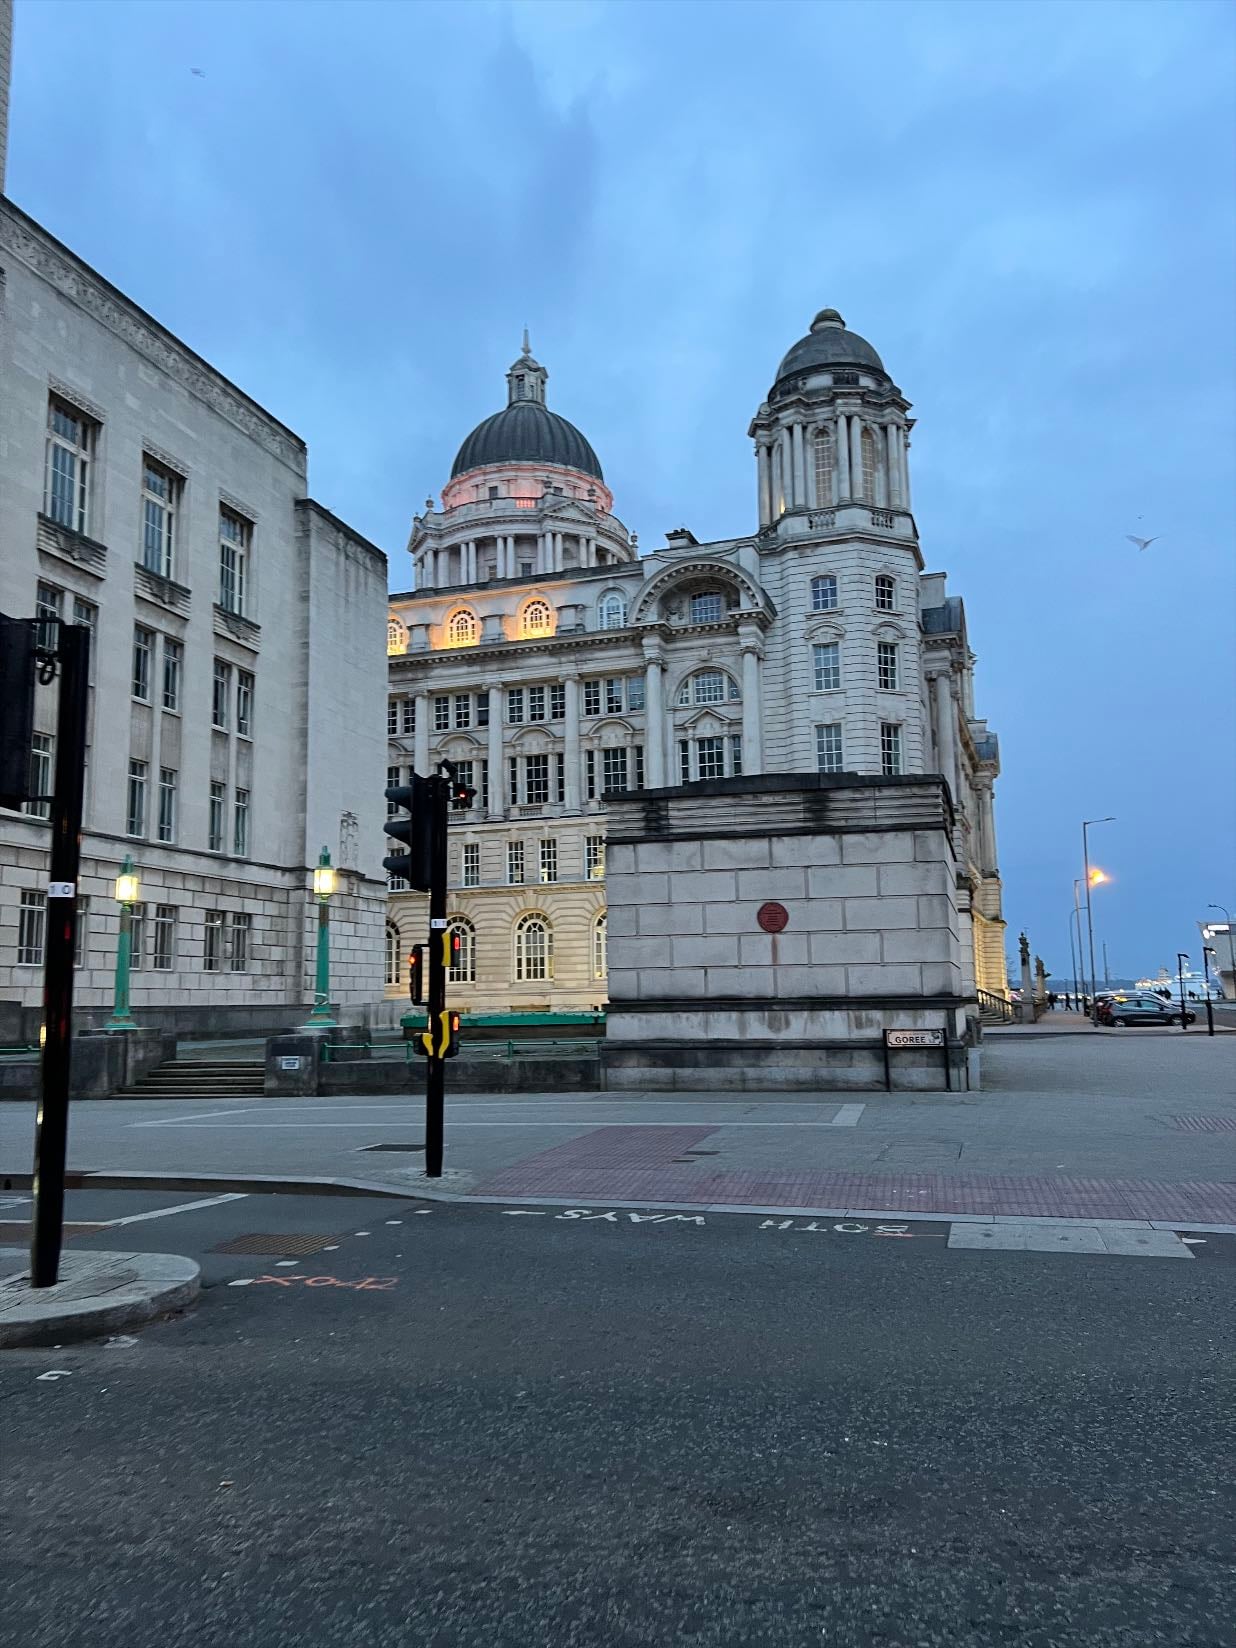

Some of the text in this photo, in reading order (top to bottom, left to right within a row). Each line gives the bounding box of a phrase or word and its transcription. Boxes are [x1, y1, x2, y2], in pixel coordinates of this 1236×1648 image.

[895, 1036, 926, 1044] GOREE
[555, 1209, 909, 1236] BOTH WAYS
